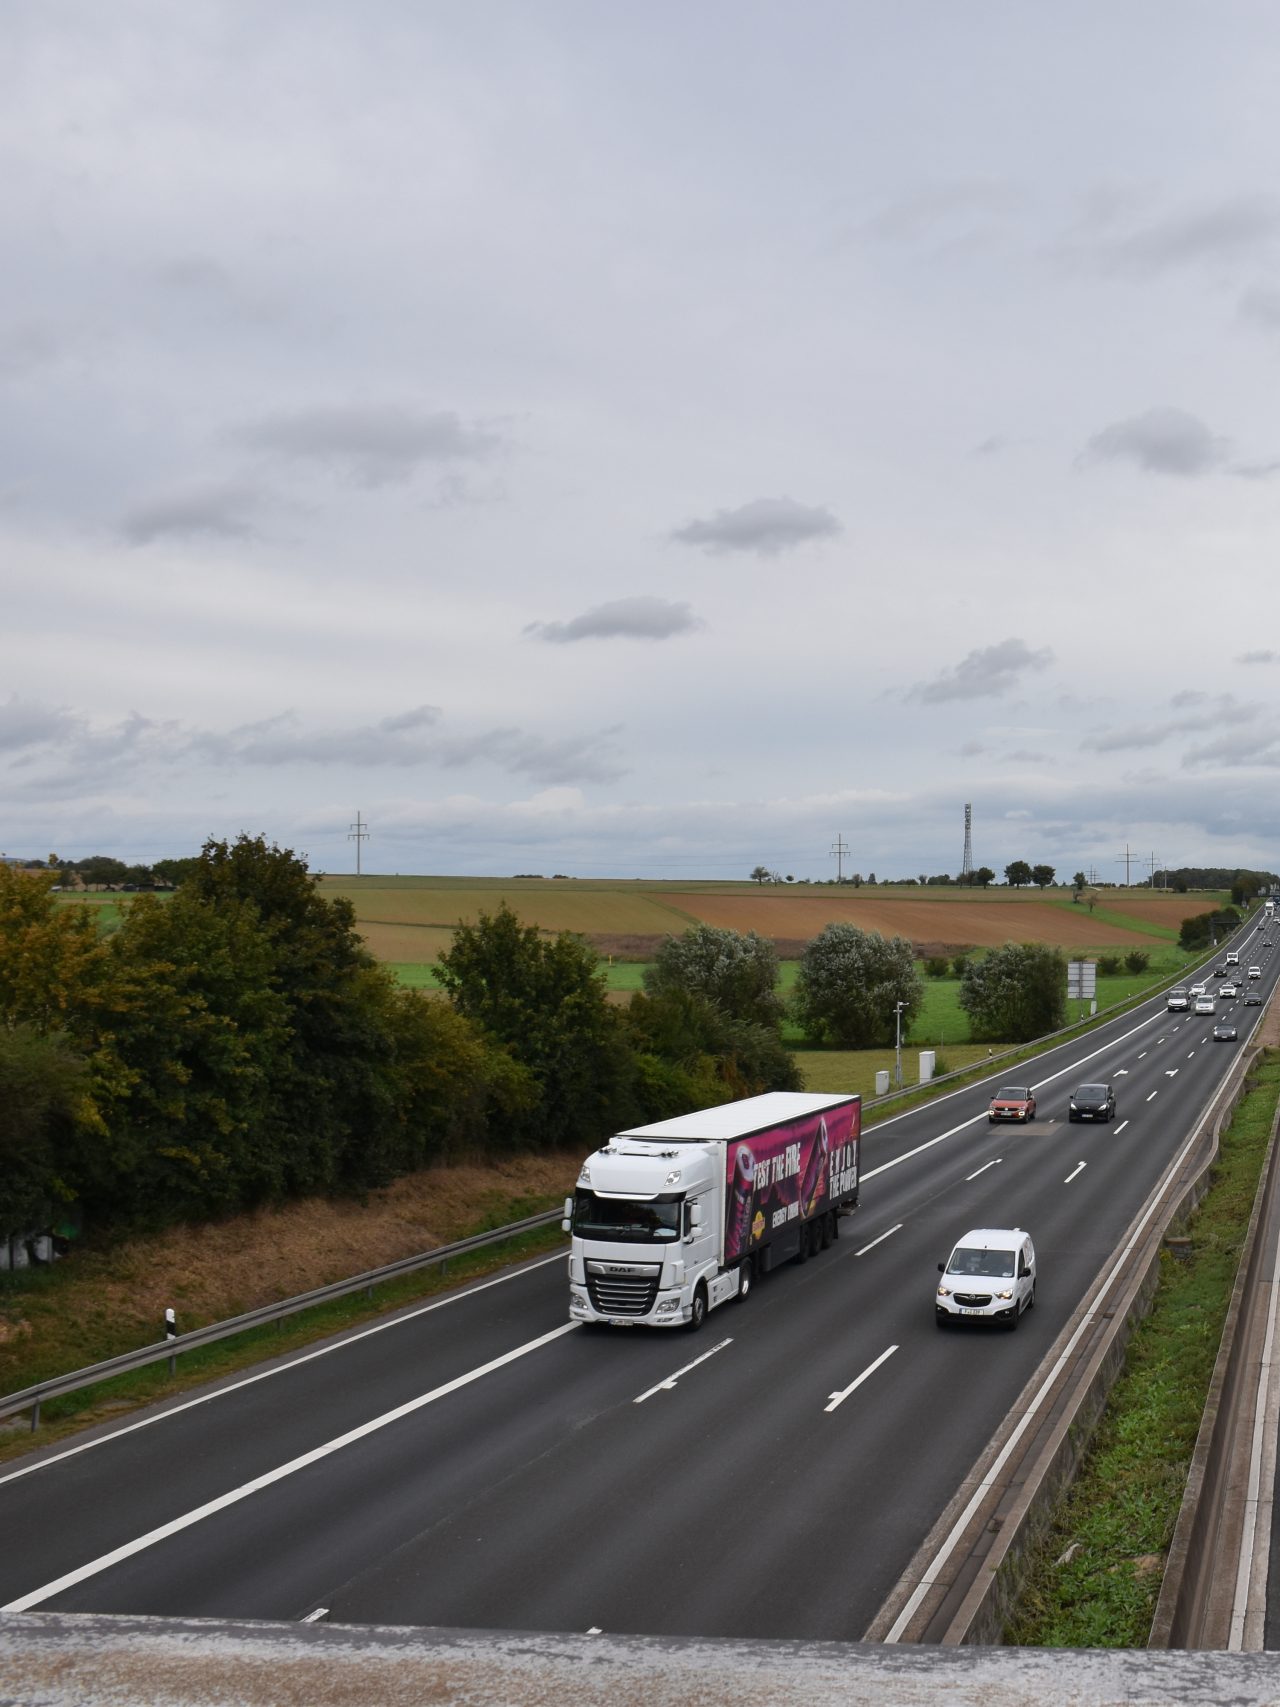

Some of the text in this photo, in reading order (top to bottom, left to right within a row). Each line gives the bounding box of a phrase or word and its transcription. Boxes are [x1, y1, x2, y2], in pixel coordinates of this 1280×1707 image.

[753, 1159, 770, 1192] TEST
[771, 1154, 784, 1184] THE
[830, 1174, 840, 1200] THE
